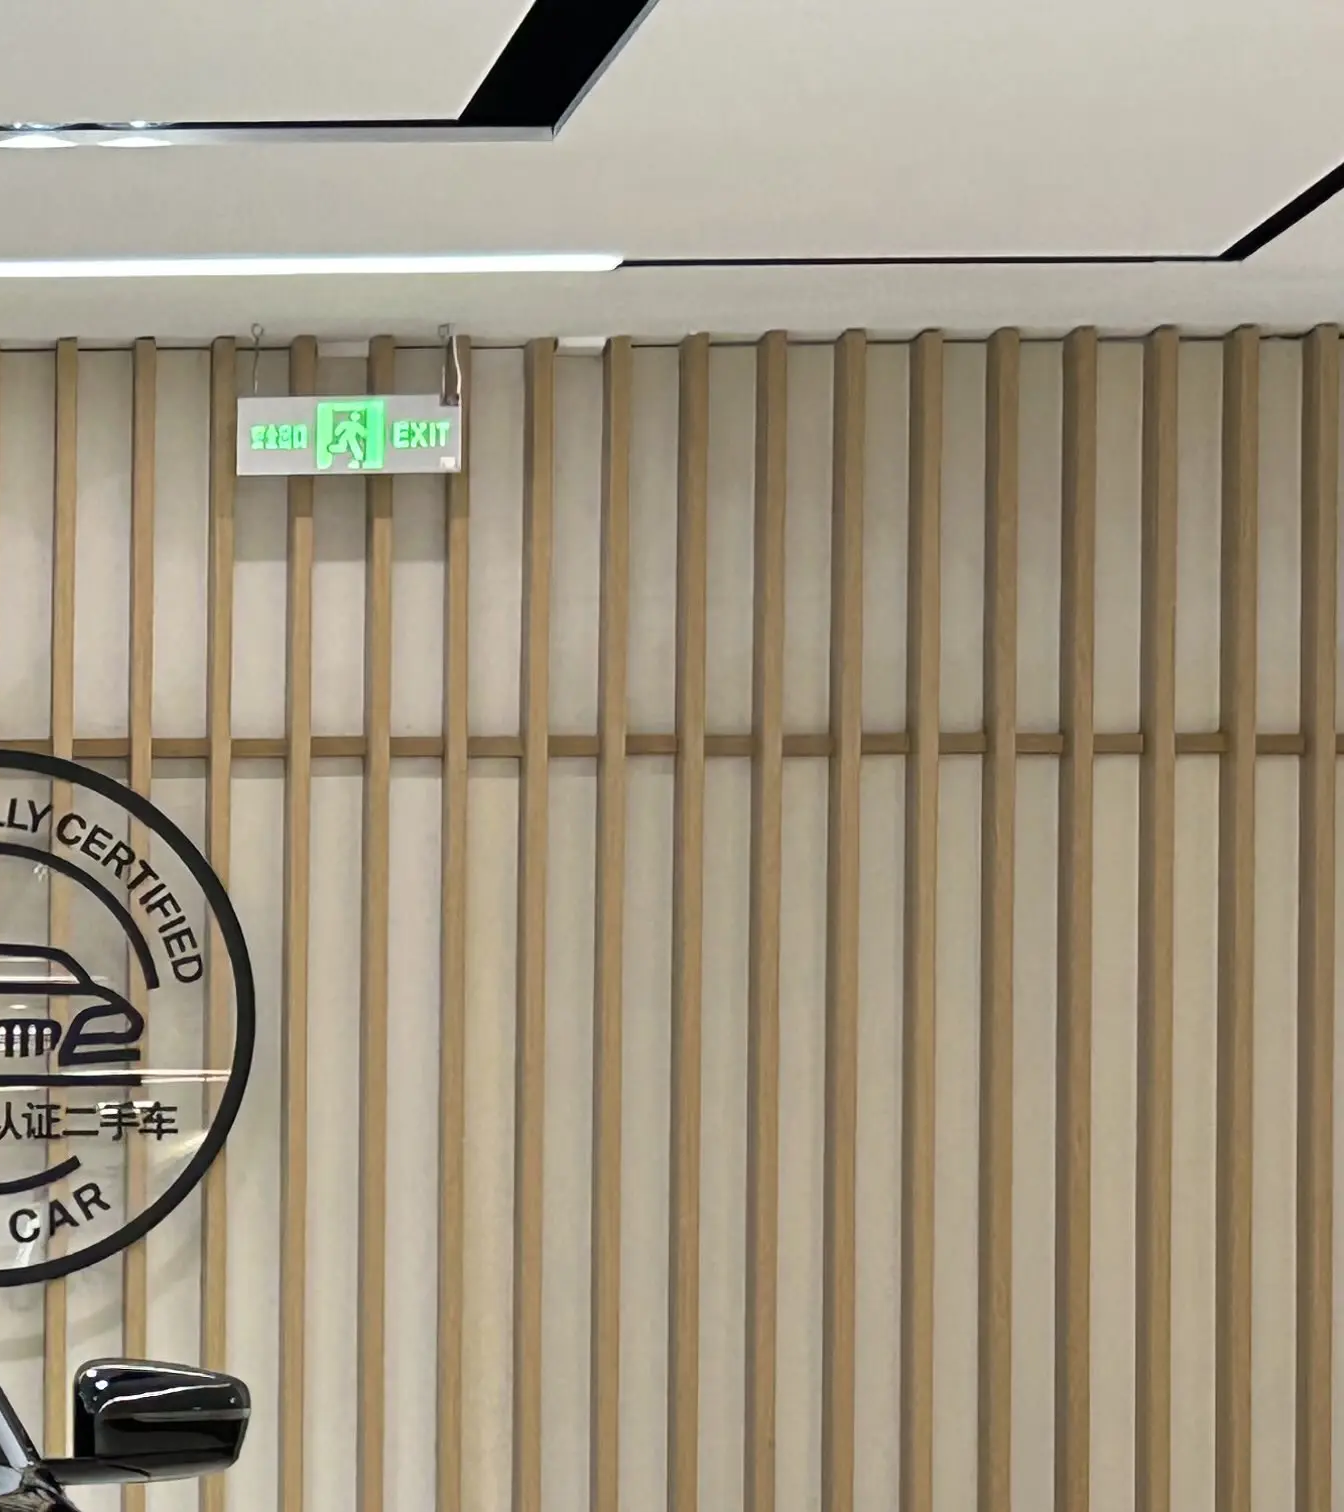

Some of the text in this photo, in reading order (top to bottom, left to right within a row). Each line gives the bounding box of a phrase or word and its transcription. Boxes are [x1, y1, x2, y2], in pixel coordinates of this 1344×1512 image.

[392, 420, 450, 449] EXIT
[56, 812, 204, 984] CERTIFIED
[8, 1181, 111, 1244] CAR
